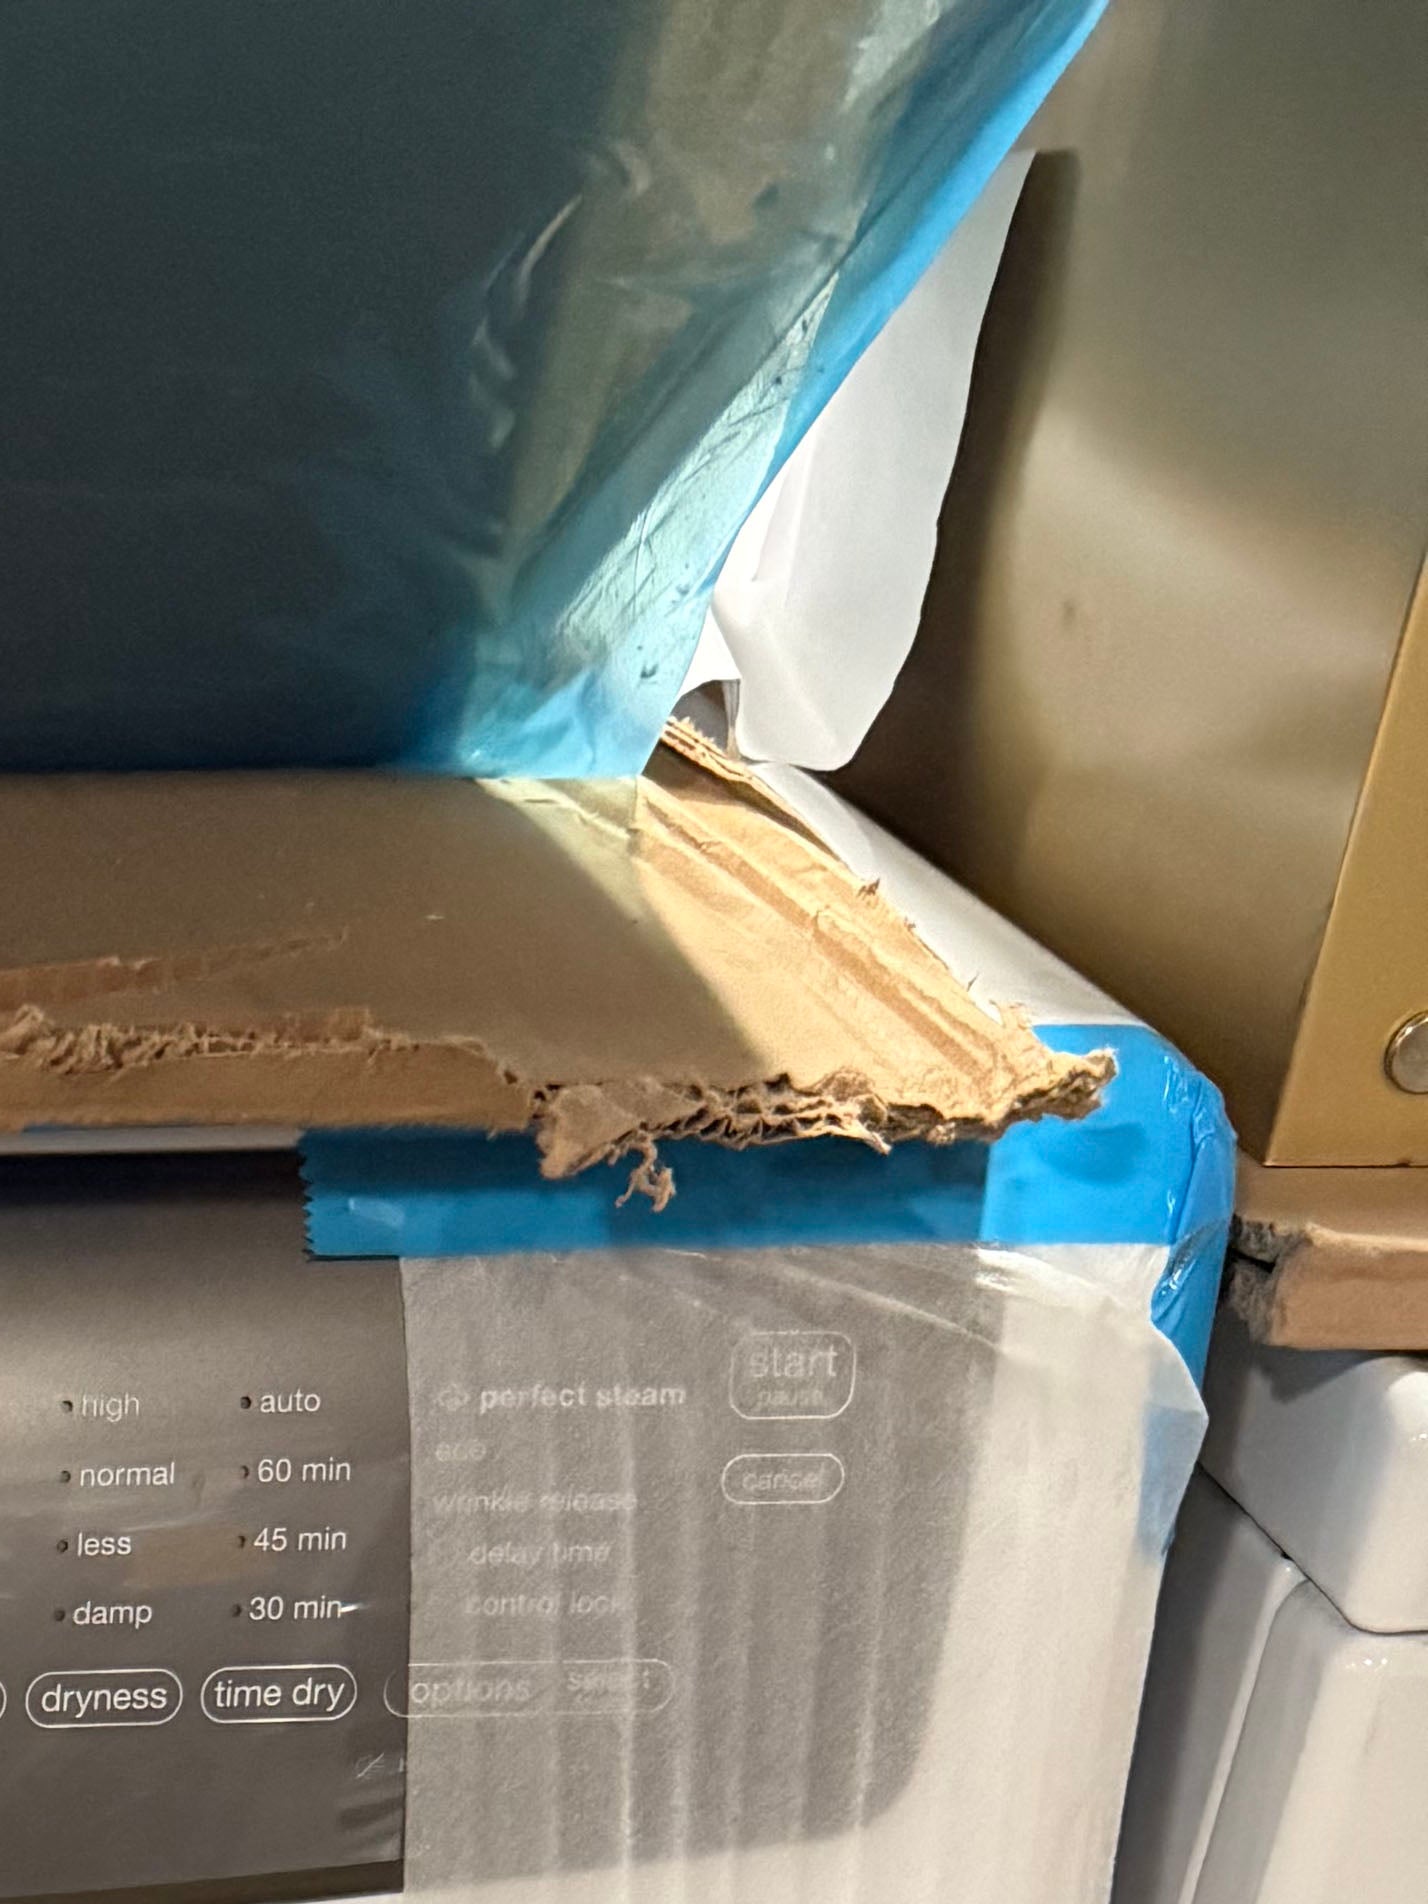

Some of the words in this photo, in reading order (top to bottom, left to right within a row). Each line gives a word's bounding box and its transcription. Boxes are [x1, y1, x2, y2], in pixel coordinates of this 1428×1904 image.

[749, 1344, 839, 1379] start
[81, 1393, 141, 1423] high
[260, 1389, 321, 1413] auto
[479, 1380, 588, 1416] perfect
[594, 1382, 688, 1409] steam
[79, 1460, 176, 1487] normal
[257, 1458, 292, 1483] 60
[302, 1456, 352, 1483] min
[77, 1531, 133, 1557] less
[253, 1526, 288, 1552] 45
[298, 1525, 347, 1551] min
[72, 1600, 153, 1630] damp
[248, 1596, 284, 1621] 30
[293, 1595, 342, 1620] min
[40, 1683, 169, 1719] dryness
[214, 1679, 282, 1708] time
[292, 1677, 345, 1712] dry
